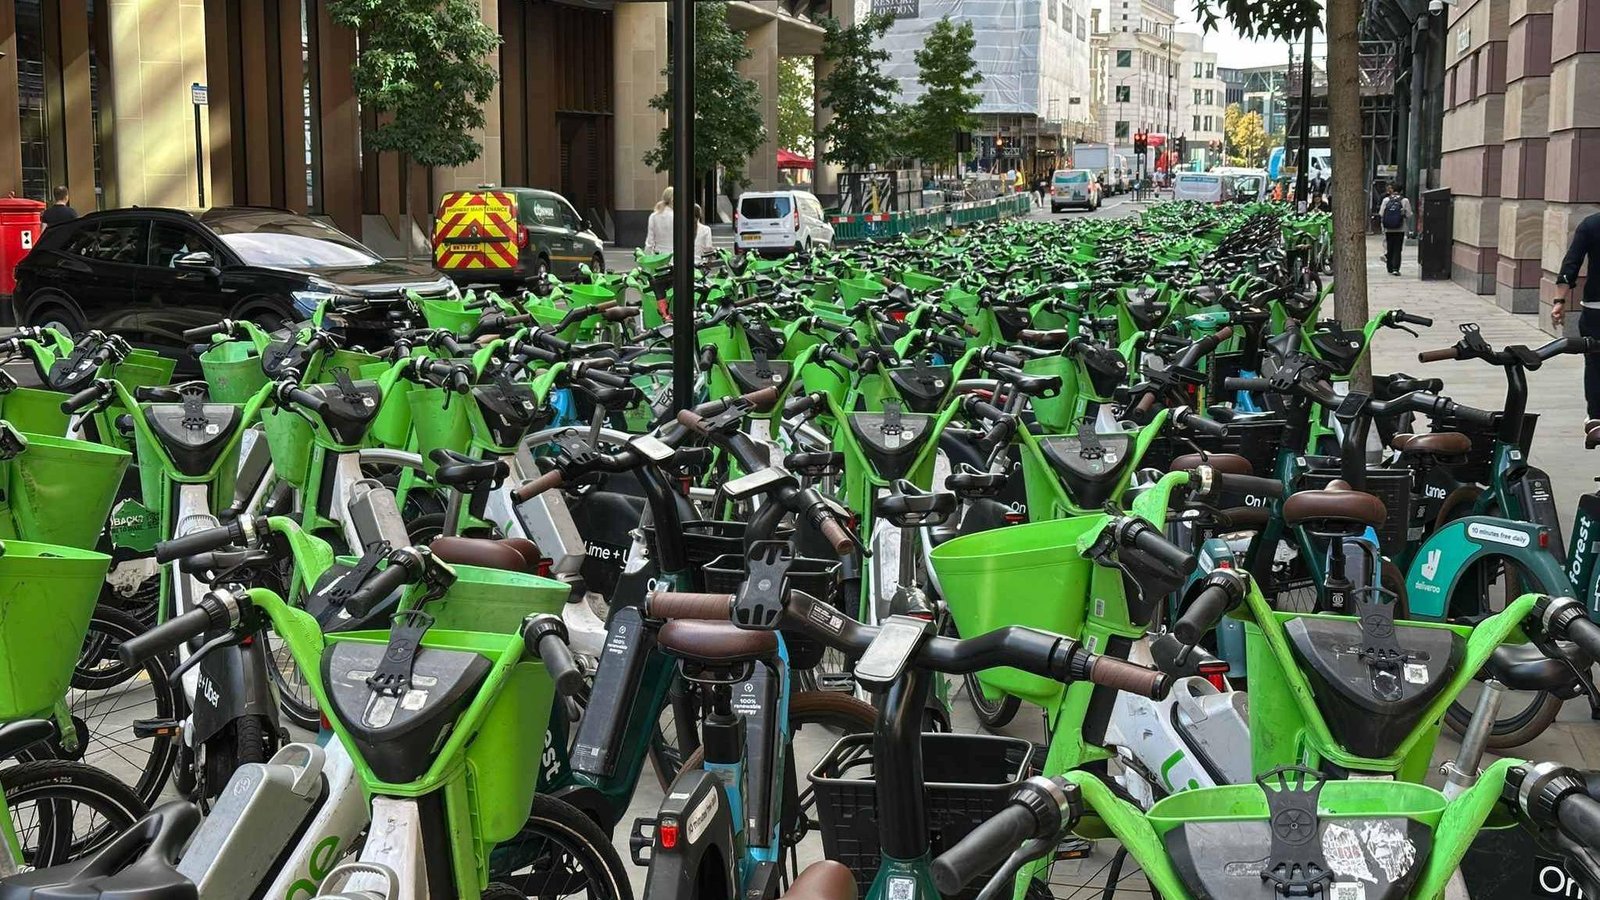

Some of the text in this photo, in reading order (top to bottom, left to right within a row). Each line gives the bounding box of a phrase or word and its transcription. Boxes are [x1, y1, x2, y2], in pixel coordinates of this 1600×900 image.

[1425, 484, 1446, 499] Lime
[1500, 532, 1512, 540] free
[1512, 535, 1527, 544] daily
[1568, 515, 1592, 585] forest
[204, 677, 220, 708] Uber
